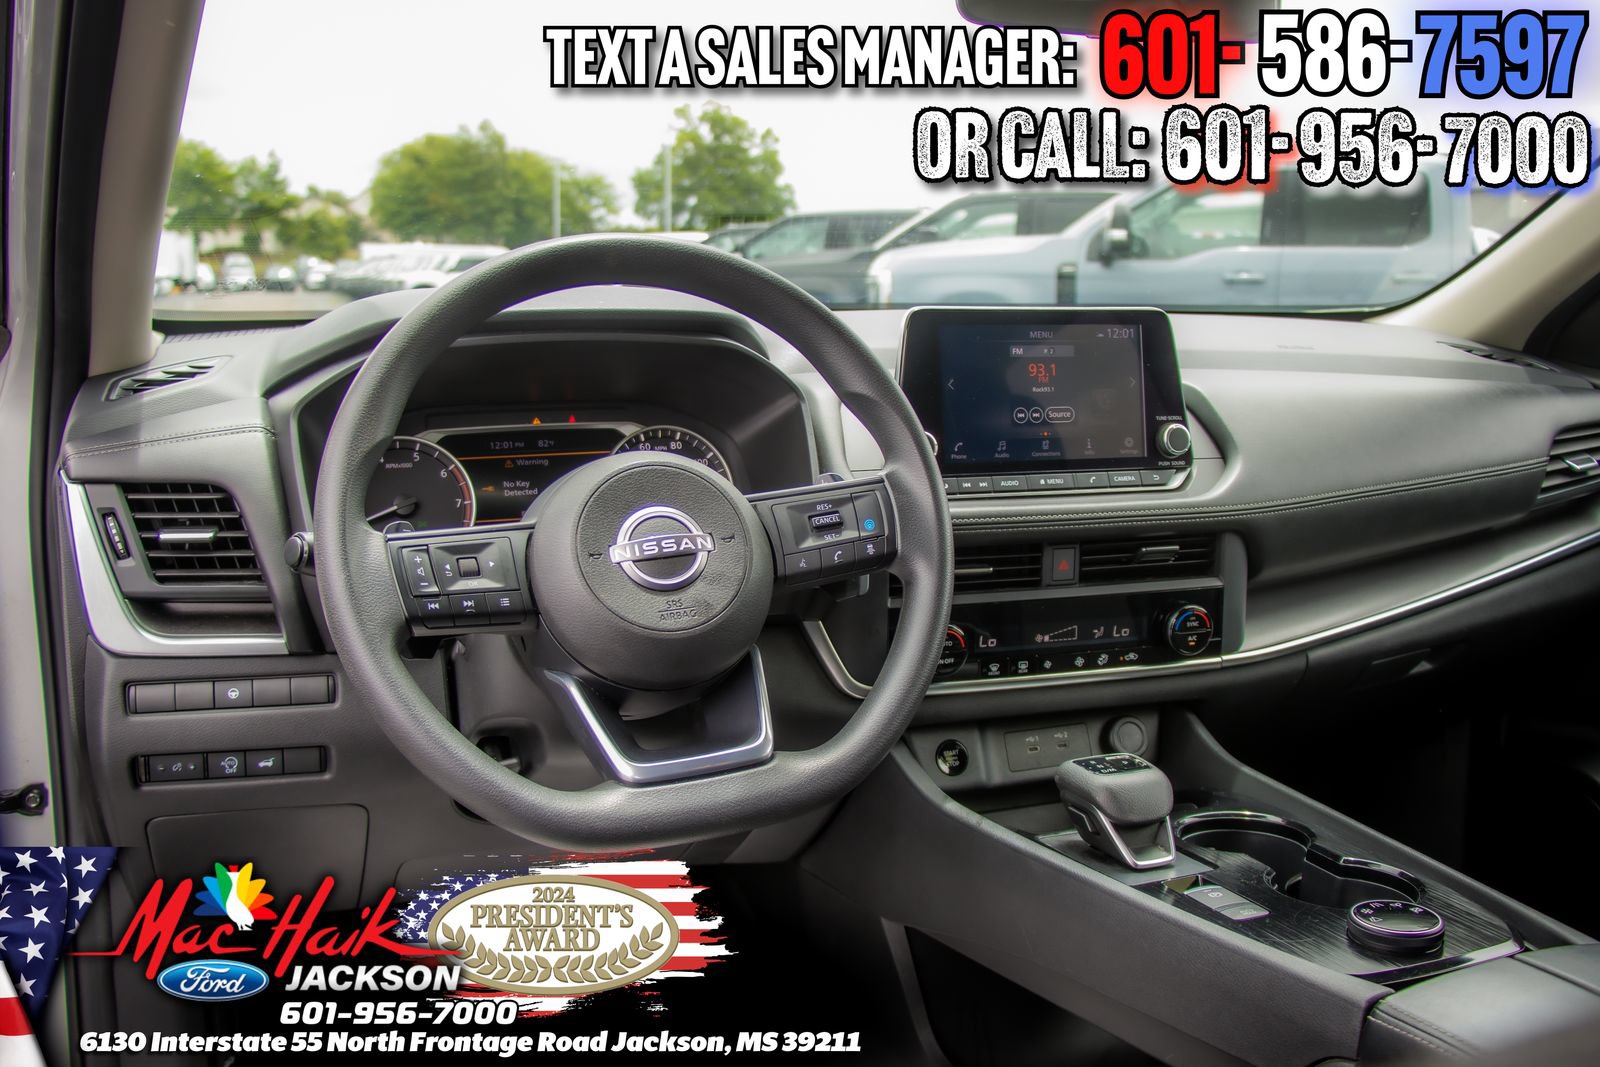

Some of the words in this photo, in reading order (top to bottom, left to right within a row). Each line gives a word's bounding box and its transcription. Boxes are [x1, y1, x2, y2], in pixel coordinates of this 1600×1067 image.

[1029, 331, 1053, 339] MENU
[1107, 328, 1134, 339] 12:01
[1012, 348, 1024, 356] FM
[1028, 363, 1057, 377] 93.1
[1048, 410, 1071, 419] Source
[490, 441, 513, 450] 12:01
[639, 443, 651, 451] 60
[670, 441, 682, 450] 80
[413, 451, 421, 462] 5
[516, 458, 549, 467] Warning
[440, 468, 448, 478] 6
[1001, 479, 1020, 487] AUDIO
[1047, 477, 1065, 485] MENU
[1114, 475, 1136, 483] CAMERA
[503, 480, 515, 488] No
[516, 480, 530, 489] Key
[504, 488, 538, 497] Detected
[455, 498, 462, 508] 7
[816, 503, 833, 511] RES+
[814, 515, 841, 526] CANCEL
[612, 536, 713, 562] NISSAN
[666, 599, 684, 610] SRS
[660, 609, 698, 622] AIRBAG
[1113, 625, 1130, 637] Lo
[979, 635, 997, 648] Lo
